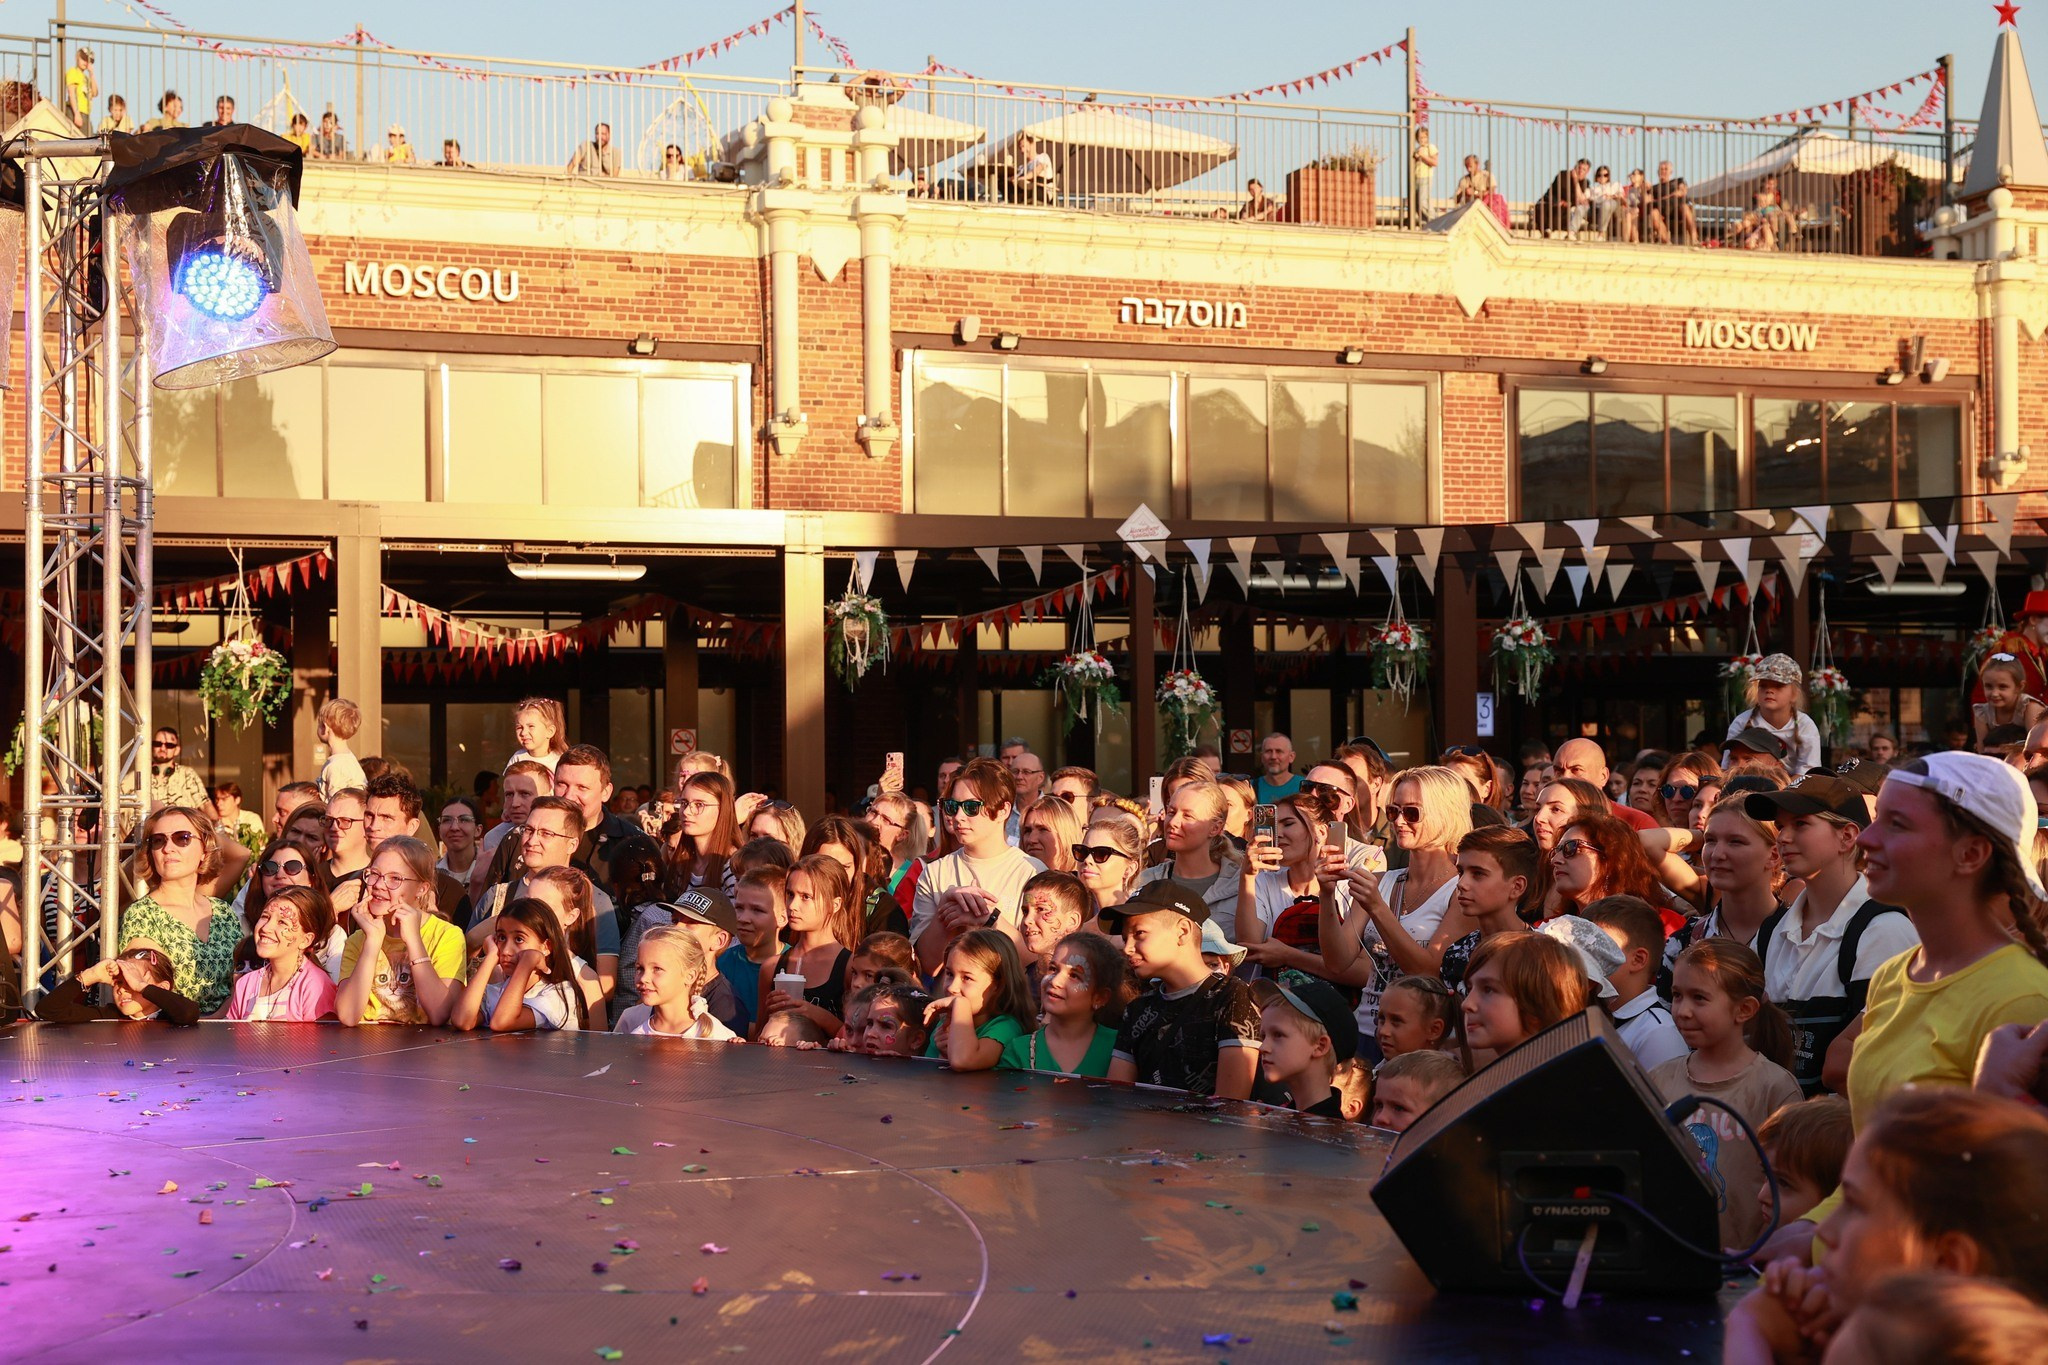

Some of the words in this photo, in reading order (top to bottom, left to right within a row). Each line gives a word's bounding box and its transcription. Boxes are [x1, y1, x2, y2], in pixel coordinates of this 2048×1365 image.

[344, 260, 519, 302] MOSCOU
[1120, 297, 1247, 328] מוסקבה
[1684, 318, 1819, 351] MOSCOW
[1479, 696, 1490, 719] 3
[1532, 1206, 1611, 1216] DYNACORD
